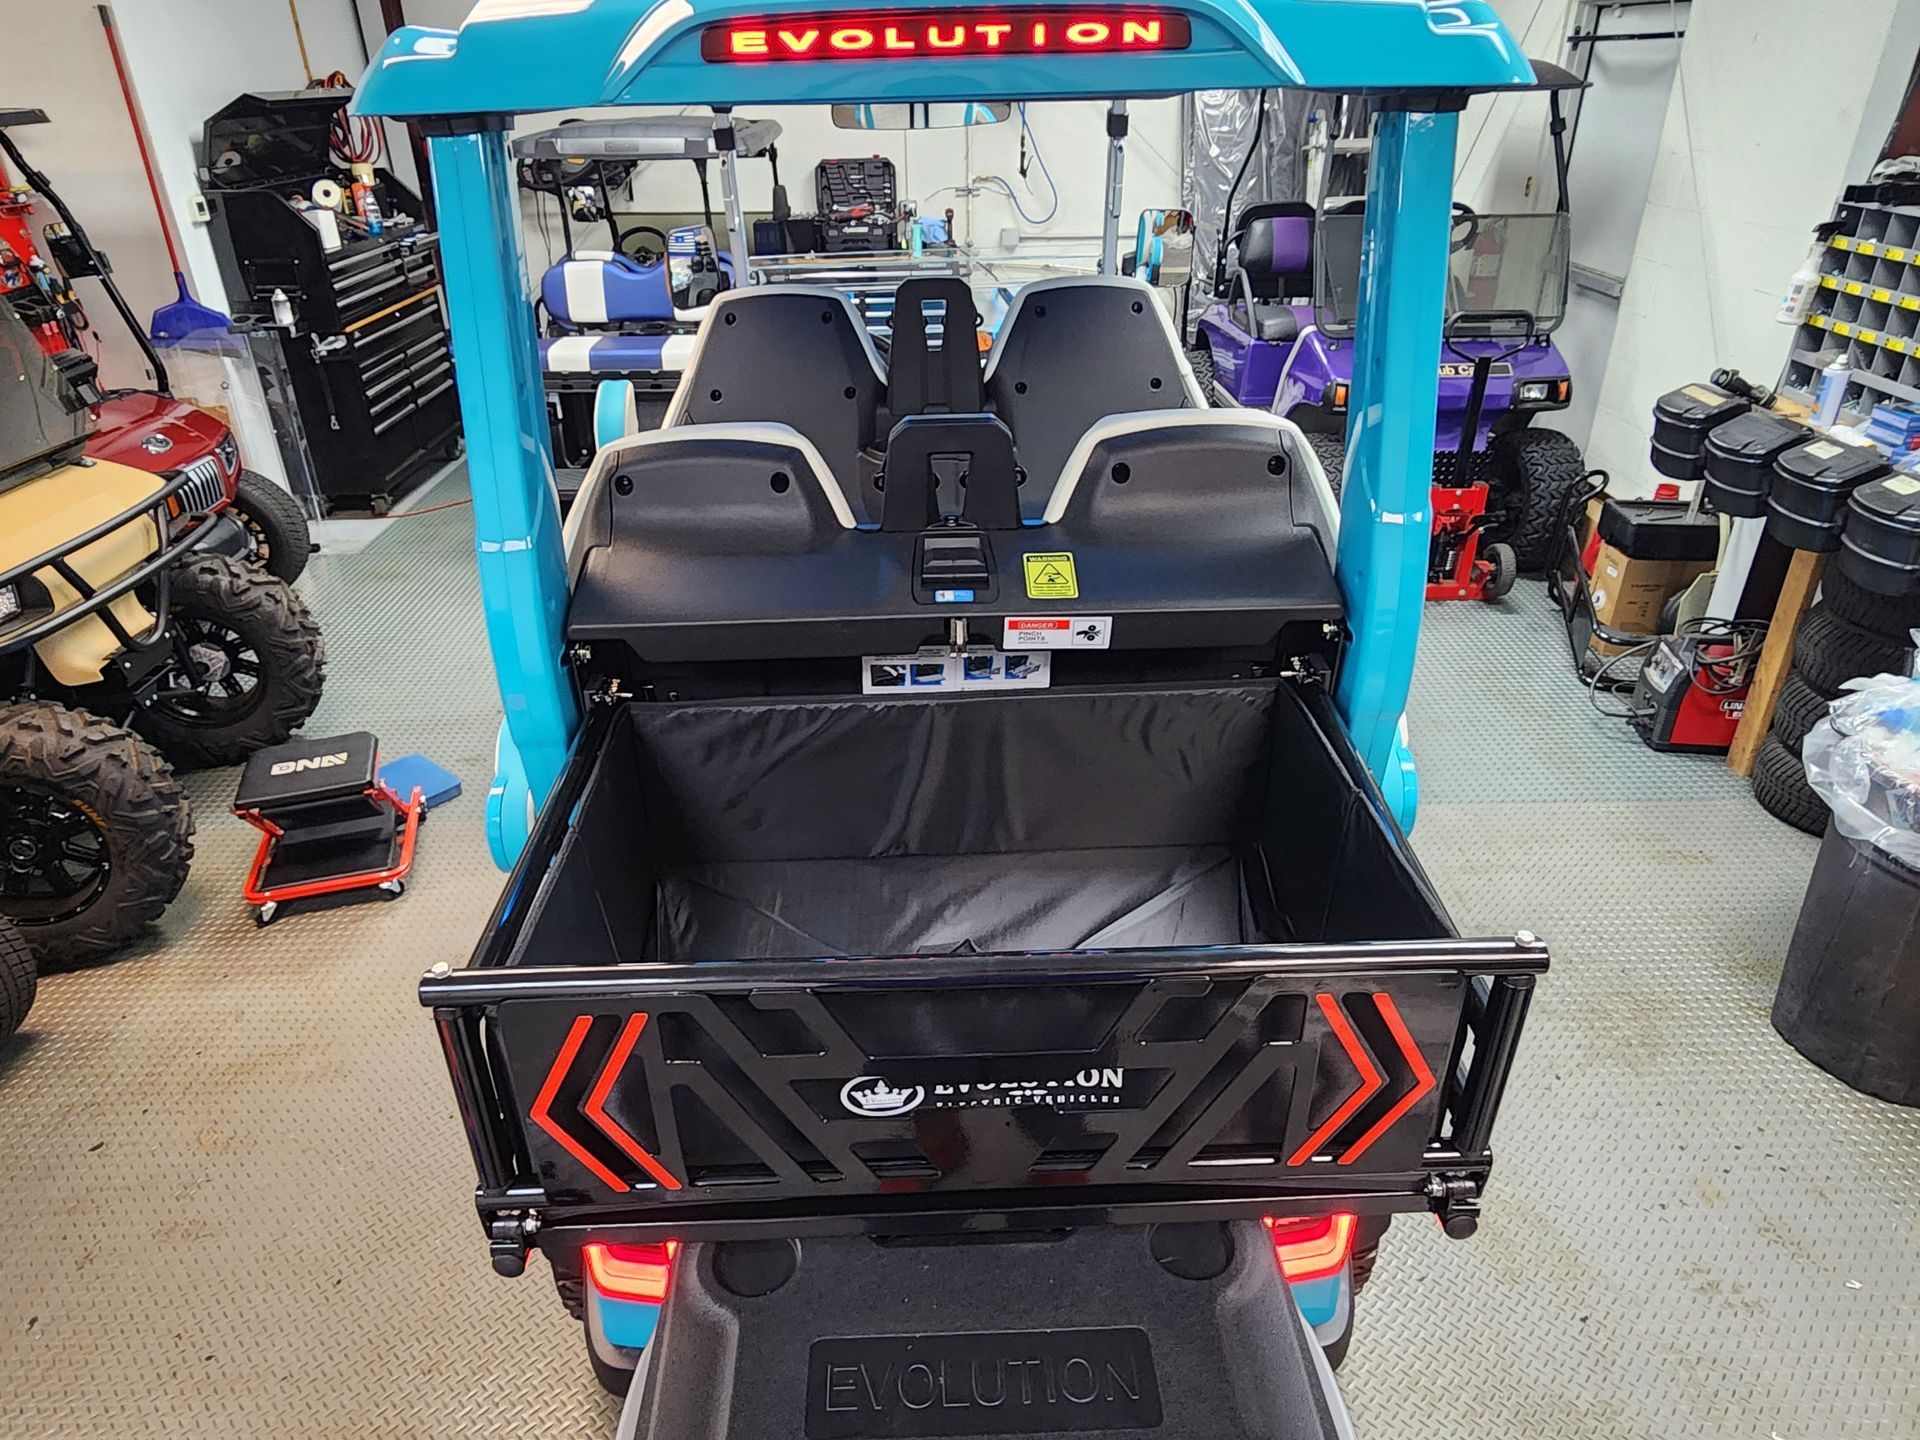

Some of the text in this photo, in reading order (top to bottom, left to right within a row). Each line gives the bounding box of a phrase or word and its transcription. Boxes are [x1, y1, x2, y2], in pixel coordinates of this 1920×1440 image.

[731, 21, 1160, 54] EVOLUTION
[1438, 365, 1455, 376] ub
[1033, 1094, 1120, 1106] VEHICLES
[826, 1353, 1140, 1411] EVOLUTION
